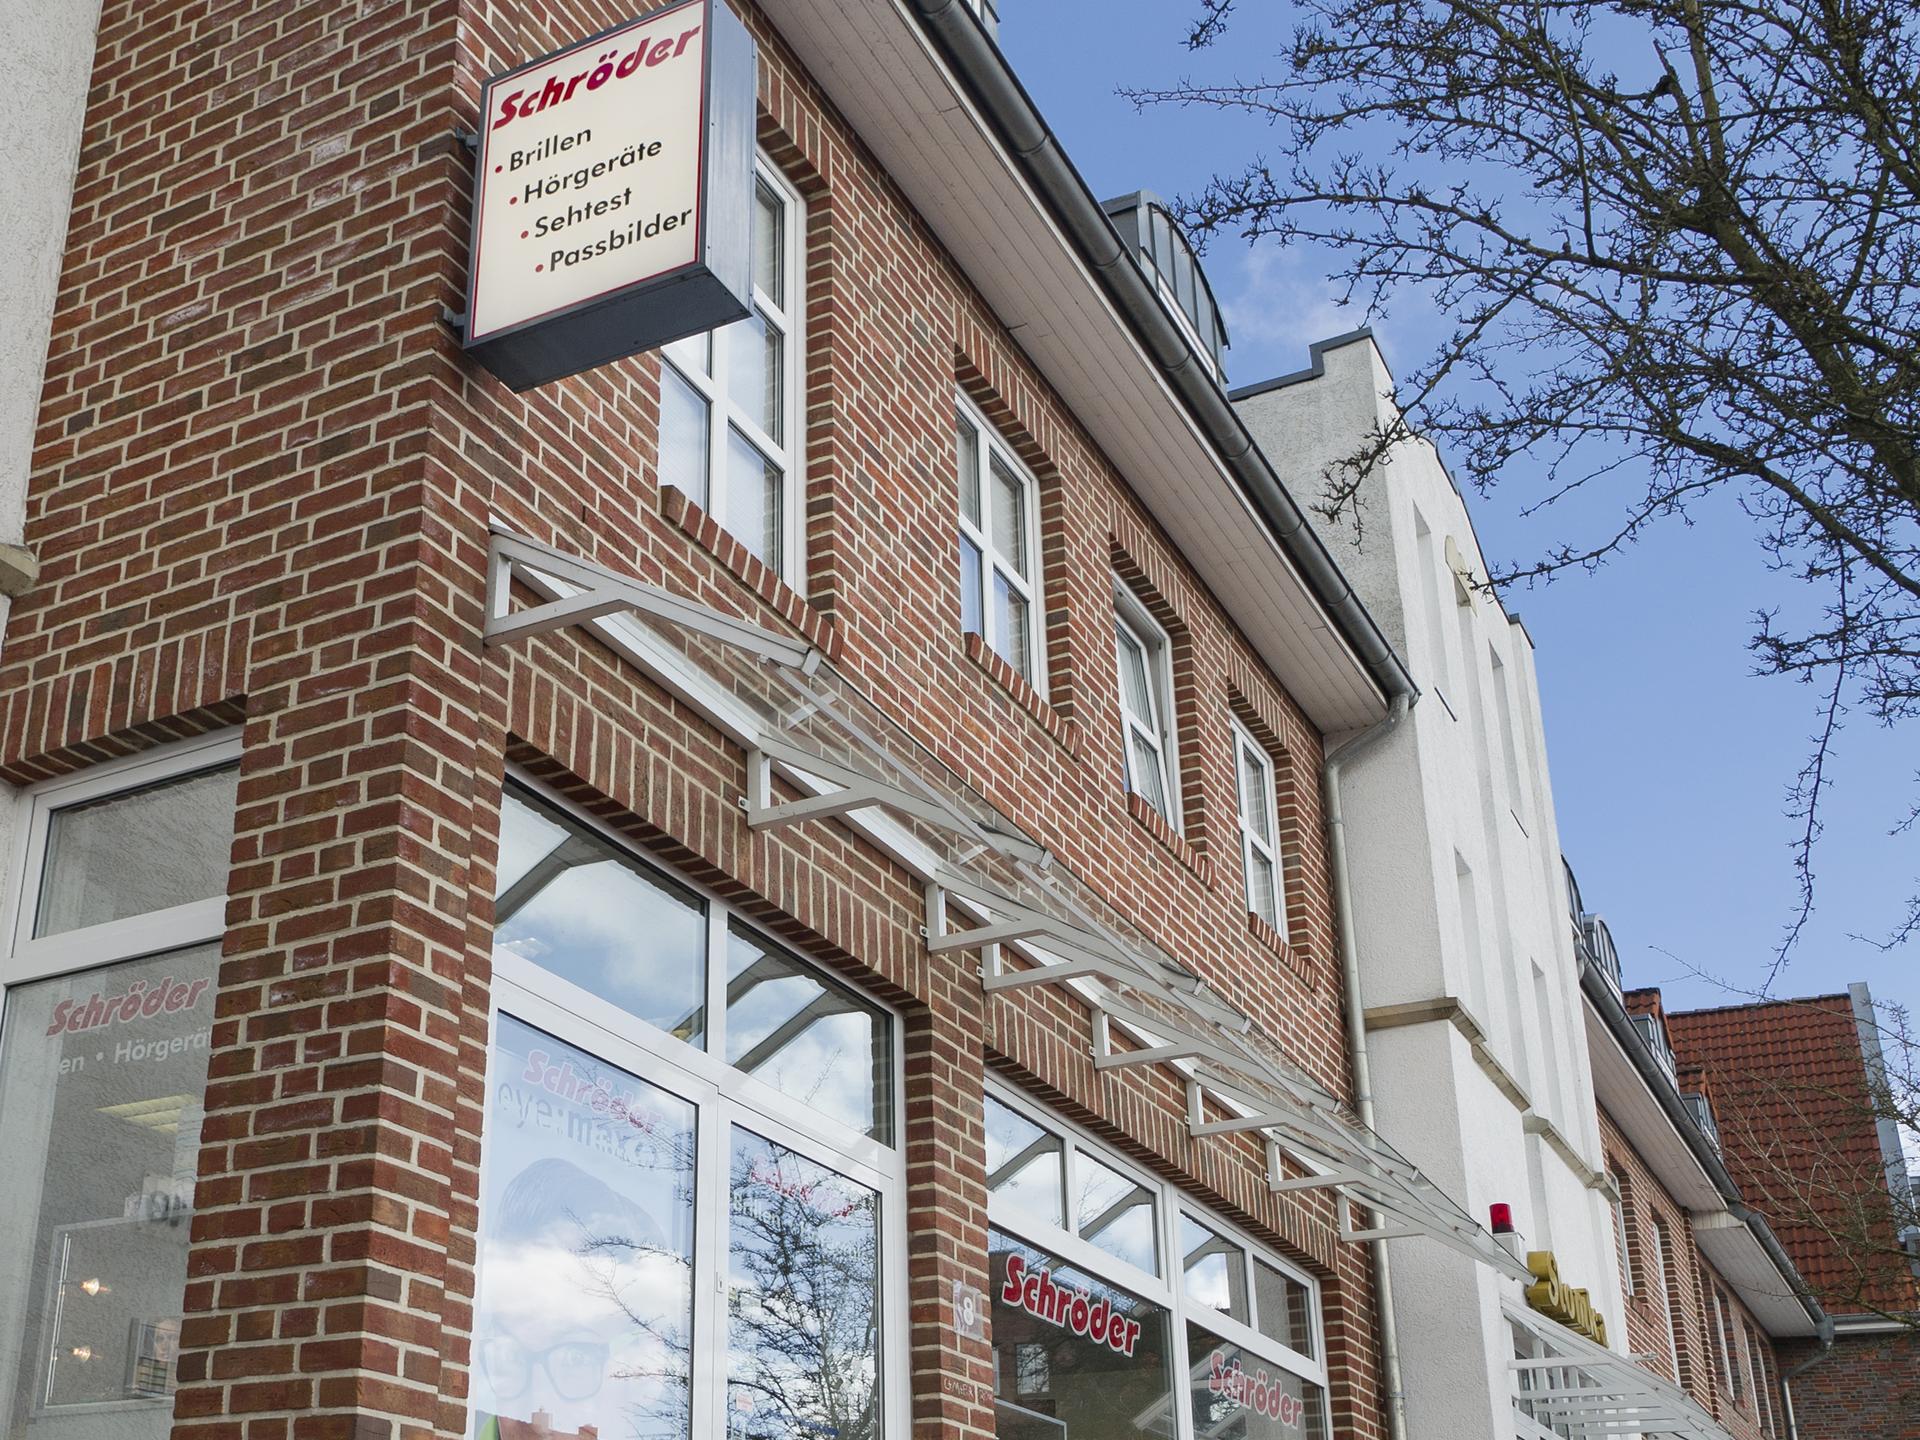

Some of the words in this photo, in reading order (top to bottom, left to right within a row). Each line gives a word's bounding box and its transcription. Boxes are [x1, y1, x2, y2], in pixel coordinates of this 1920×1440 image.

[492, 25, 701, 130] Schröder
[509, 128, 592, 172] Brillen
[524, 140, 663, 204] Hörgeräte
[534, 187, 632, 239] Sehtest
[550, 208, 692, 272] Passbilder
[46, 977, 209, 1037] Schröder
[114, 1027, 211, 1065] Hörgerä
[1002, 1252, 1140, 1358] Schröder
[1209, 1349, 1304, 1429] Schröder
